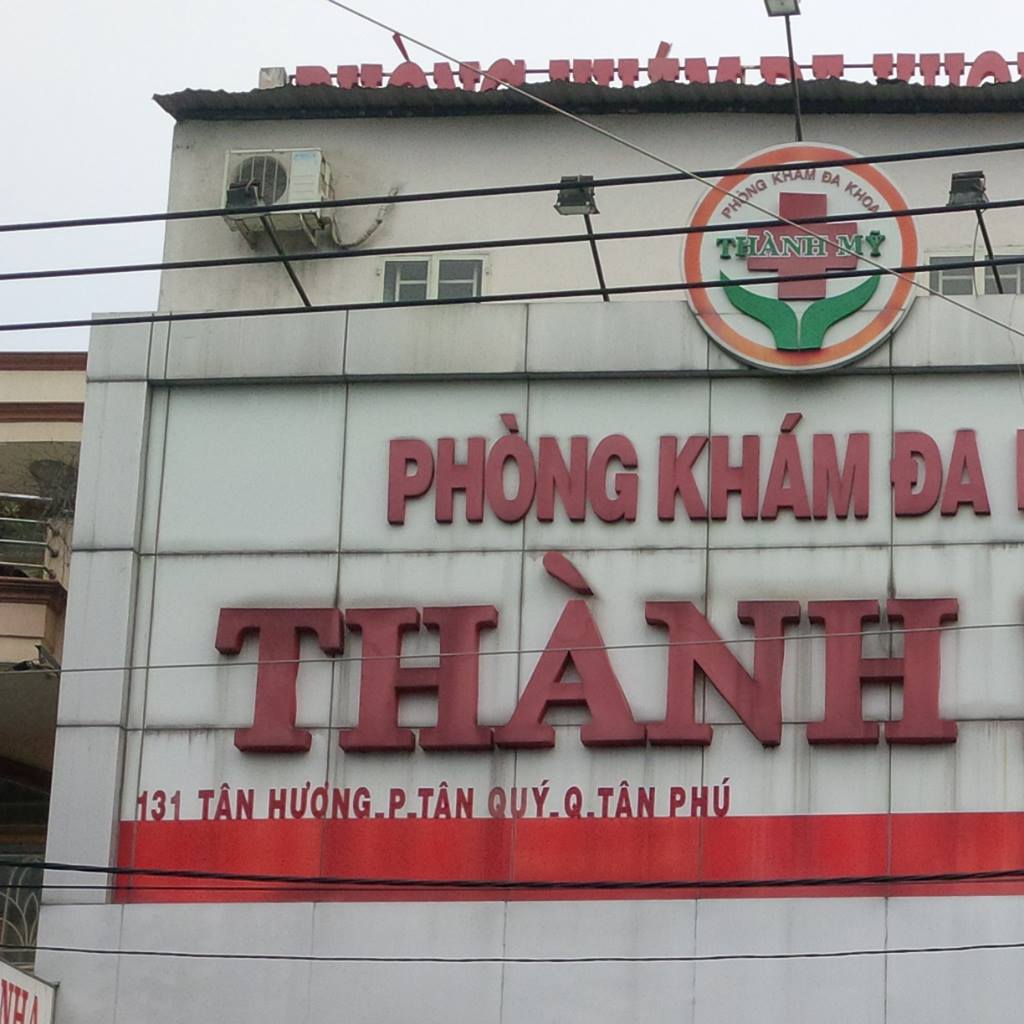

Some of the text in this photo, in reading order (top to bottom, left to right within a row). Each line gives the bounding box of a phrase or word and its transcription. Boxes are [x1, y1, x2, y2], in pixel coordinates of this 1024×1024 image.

[821, 170, 841, 187] ĐA
[844, 181, 881, 213] KHOA
[716, 229, 829, 260] THÀNH
[387, 413, 639, 525] PHÒNG
[657, 412, 870, 521] KHÁM
[890, 428, 991, 518] ĐA
[215, 551, 959, 753] THÀNH
[137, 789, 181, 821] 131
[198, 782, 255, 820] TÂN
[670, 777, 730, 817] PHÚ
